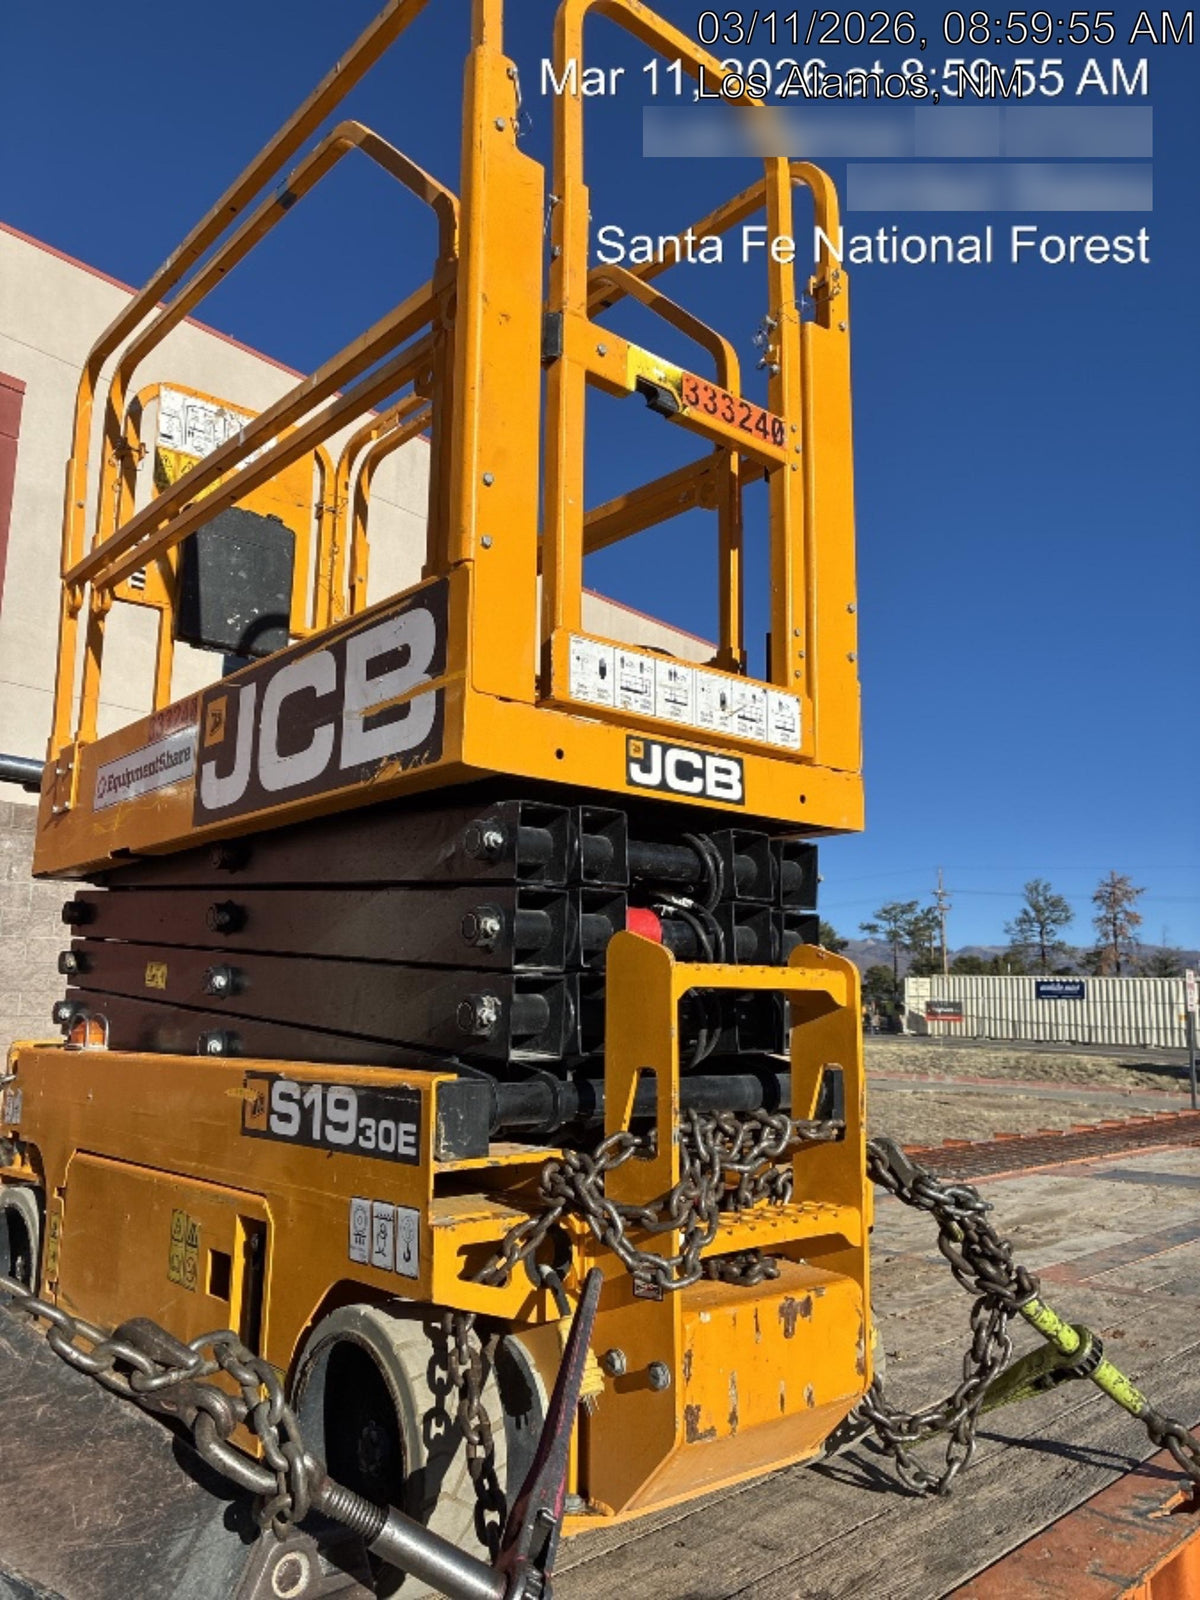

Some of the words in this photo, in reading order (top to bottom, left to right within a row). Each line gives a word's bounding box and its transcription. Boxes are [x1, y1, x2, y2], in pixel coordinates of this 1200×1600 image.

[683, 376, 786, 447] 333240
[201, 607, 437, 810] JCB
[105, 745, 192, 794] EquipmentShare
[628, 743, 743, 801] JCB
